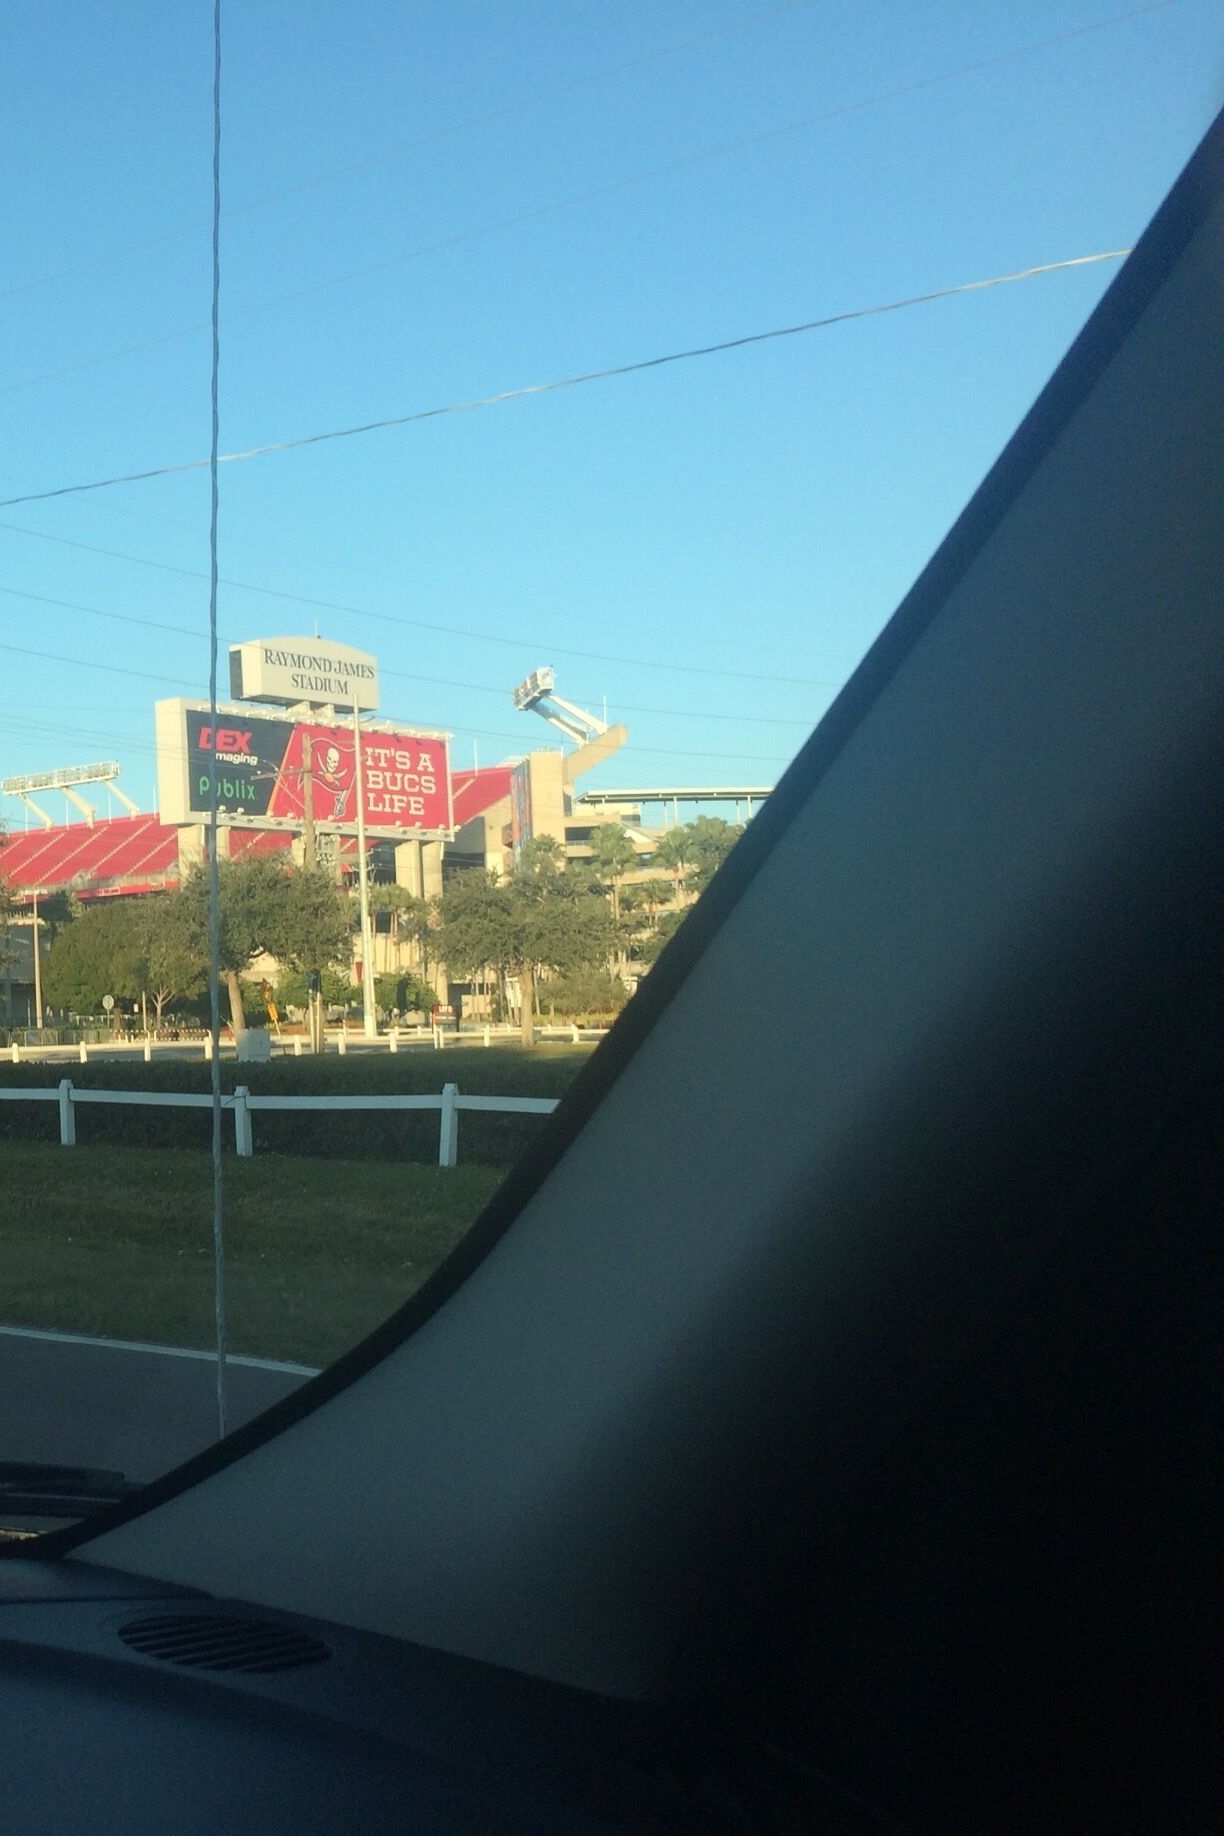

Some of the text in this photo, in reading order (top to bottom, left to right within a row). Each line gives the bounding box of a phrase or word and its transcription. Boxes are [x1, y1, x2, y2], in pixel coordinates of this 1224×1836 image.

[264, 649, 375, 679] RAYMOND JAMES
[291, 673, 349, 695] STADIUM
[365, 747, 435, 773] IT'S A
[366, 770, 436, 795] BUCS
[367, 792, 425, 816] LIFE
